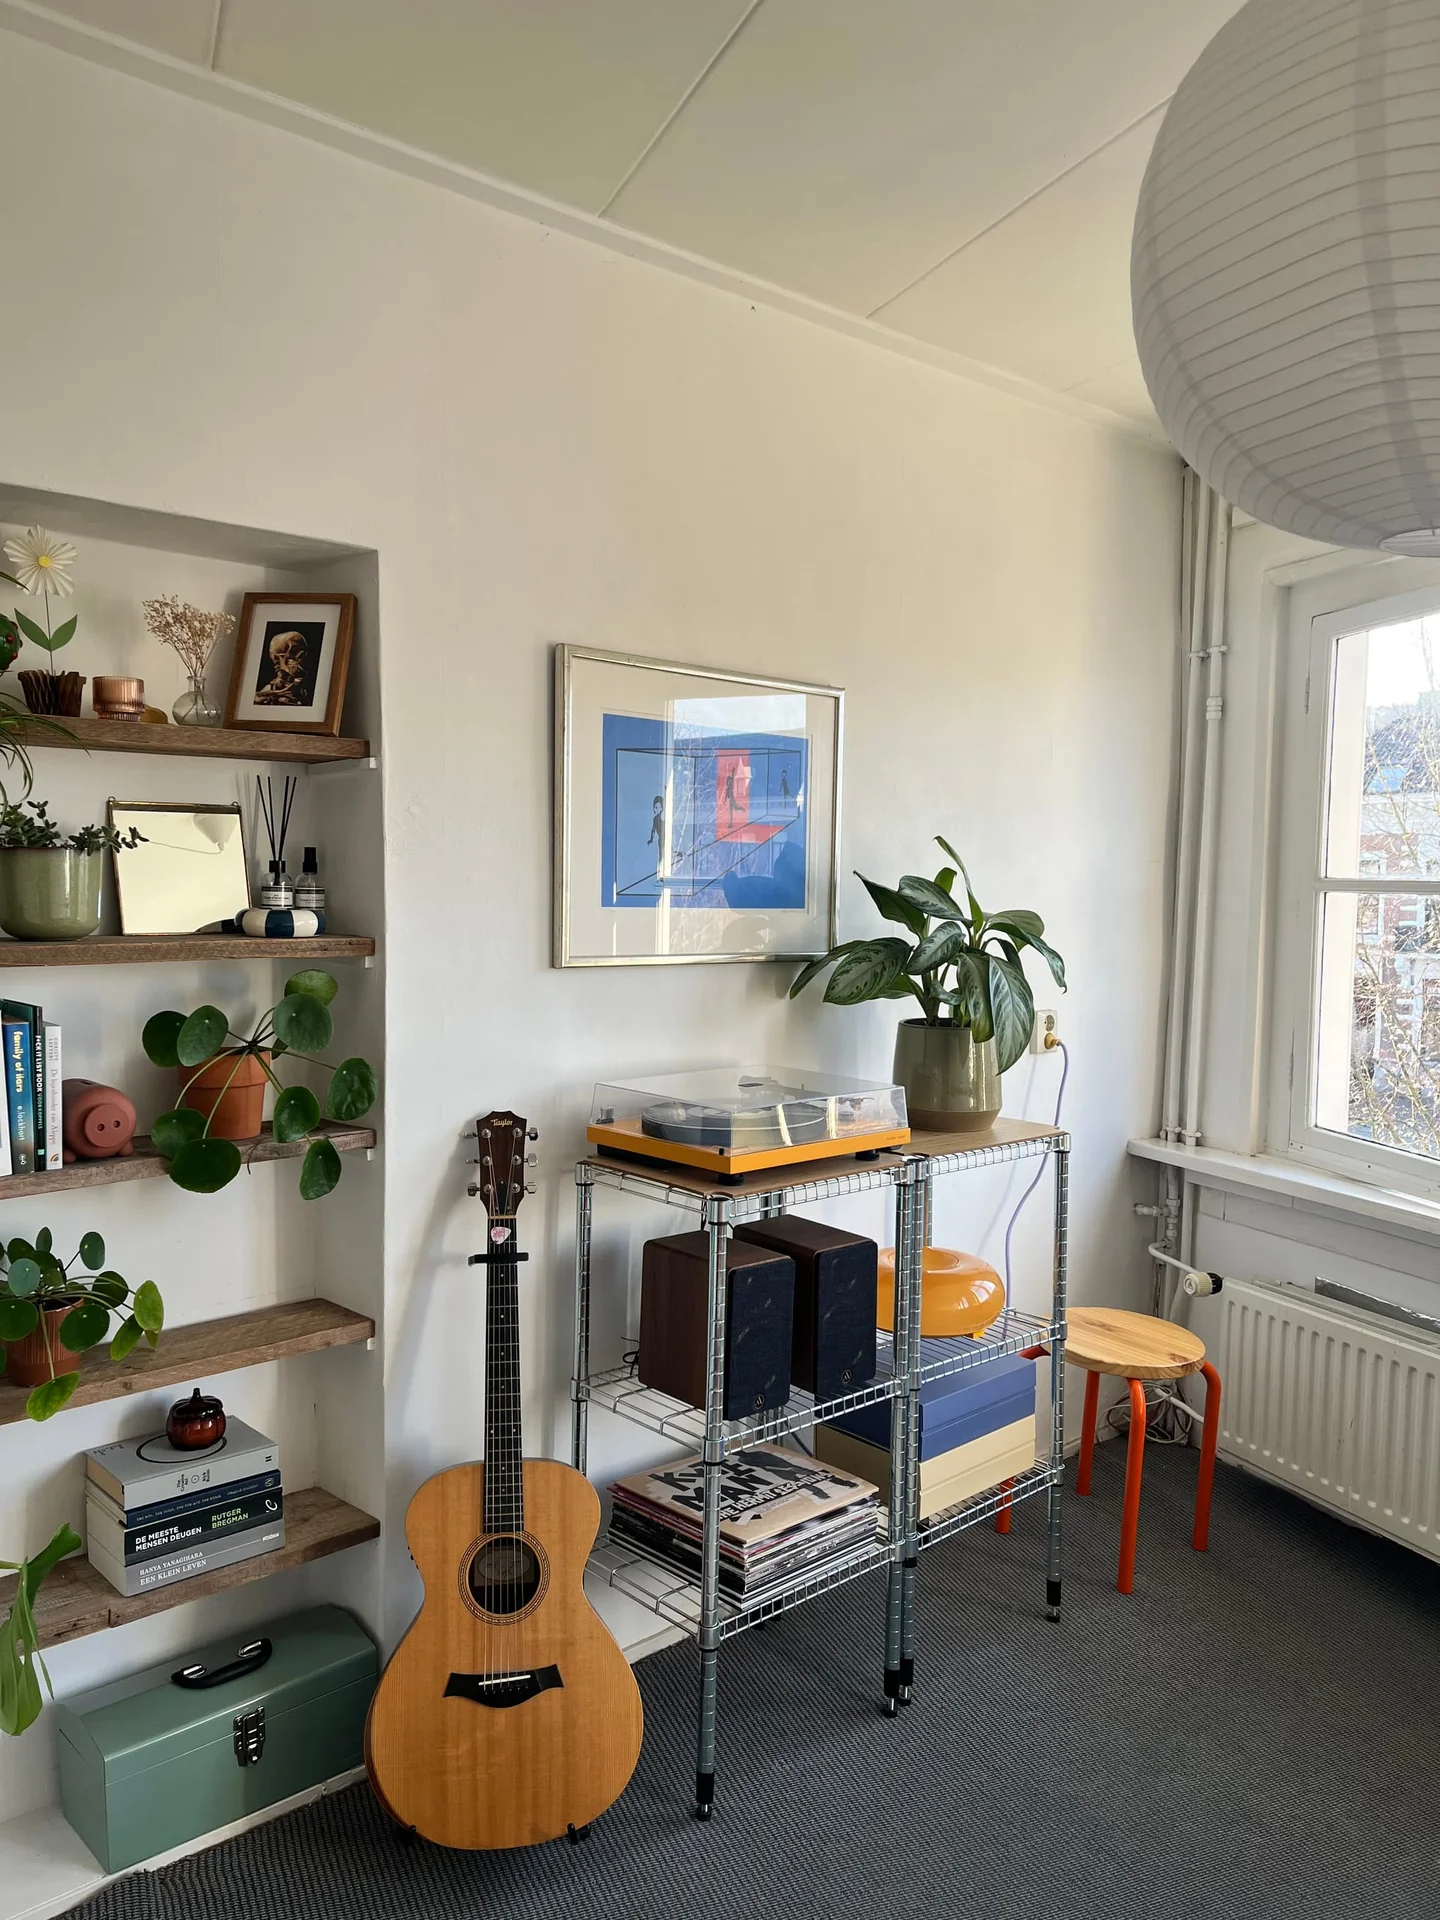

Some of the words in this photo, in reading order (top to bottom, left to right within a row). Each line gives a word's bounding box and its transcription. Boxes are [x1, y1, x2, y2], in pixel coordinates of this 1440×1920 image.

[12, 1031, 24, 1060] family
[15, 1062, 24, 1072] of
[16, 1074, 24, 1092] liars
[16, 1106, 26, 1140] e.lockhart
[491, 1118, 514, 1128] Taylor
[212, 1508, 241, 1522] RUTGER
[212, 1513, 248, 1529] BREGMAN
[136, 1535, 146, 1544] DE
[148, 1526, 179, 1540] MEESTE
[136, 1536, 168, 1552] MENSEN
[170, 1526, 202, 1542] DEUGEN
[140, 1565, 161, 1576] HANYA
[163, 1552, 203, 1568] YANAGIHARA
[140, 1576, 156, 1586] EEN
[158, 1568, 180, 1580] KLEIN
[182, 1559, 207, 1572] LEVEN
